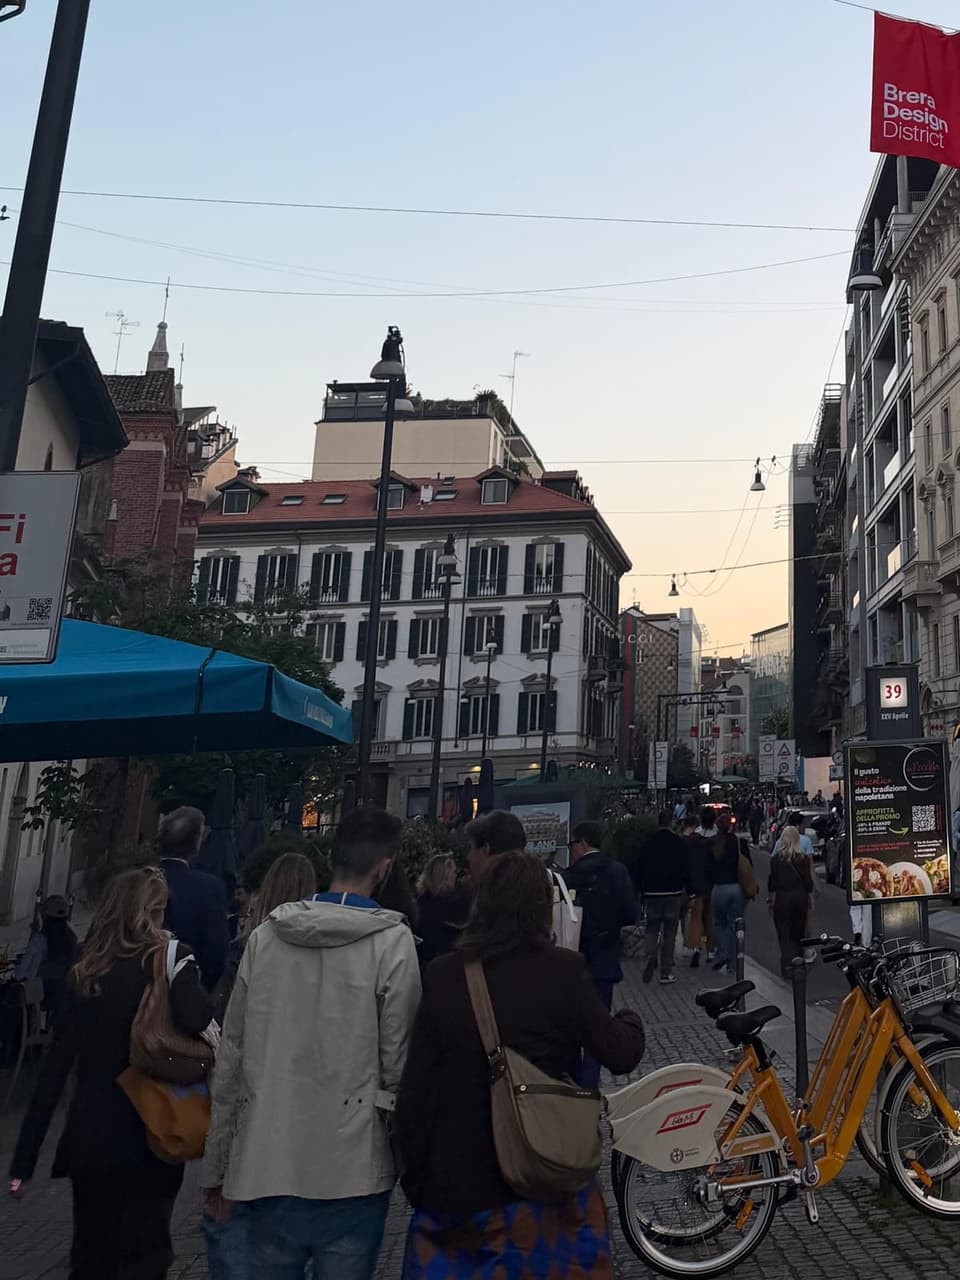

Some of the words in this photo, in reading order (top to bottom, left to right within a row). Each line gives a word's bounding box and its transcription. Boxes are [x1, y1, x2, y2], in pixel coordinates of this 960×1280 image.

[884, 83, 936, 110] Brera
[883, 102, 949, 133] Design
[883, 121, 945, 149] District
[885, 684, 902, 699] 39
[859, 768, 880, 777] gusto
[855, 786, 872, 794] della
[873, 784, 907, 793] tradizione
[855, 793, 894, 802] napoletana
[856, 808, 895, 816] APPROFITTA
[876, 813, 901, 821] PROMO
